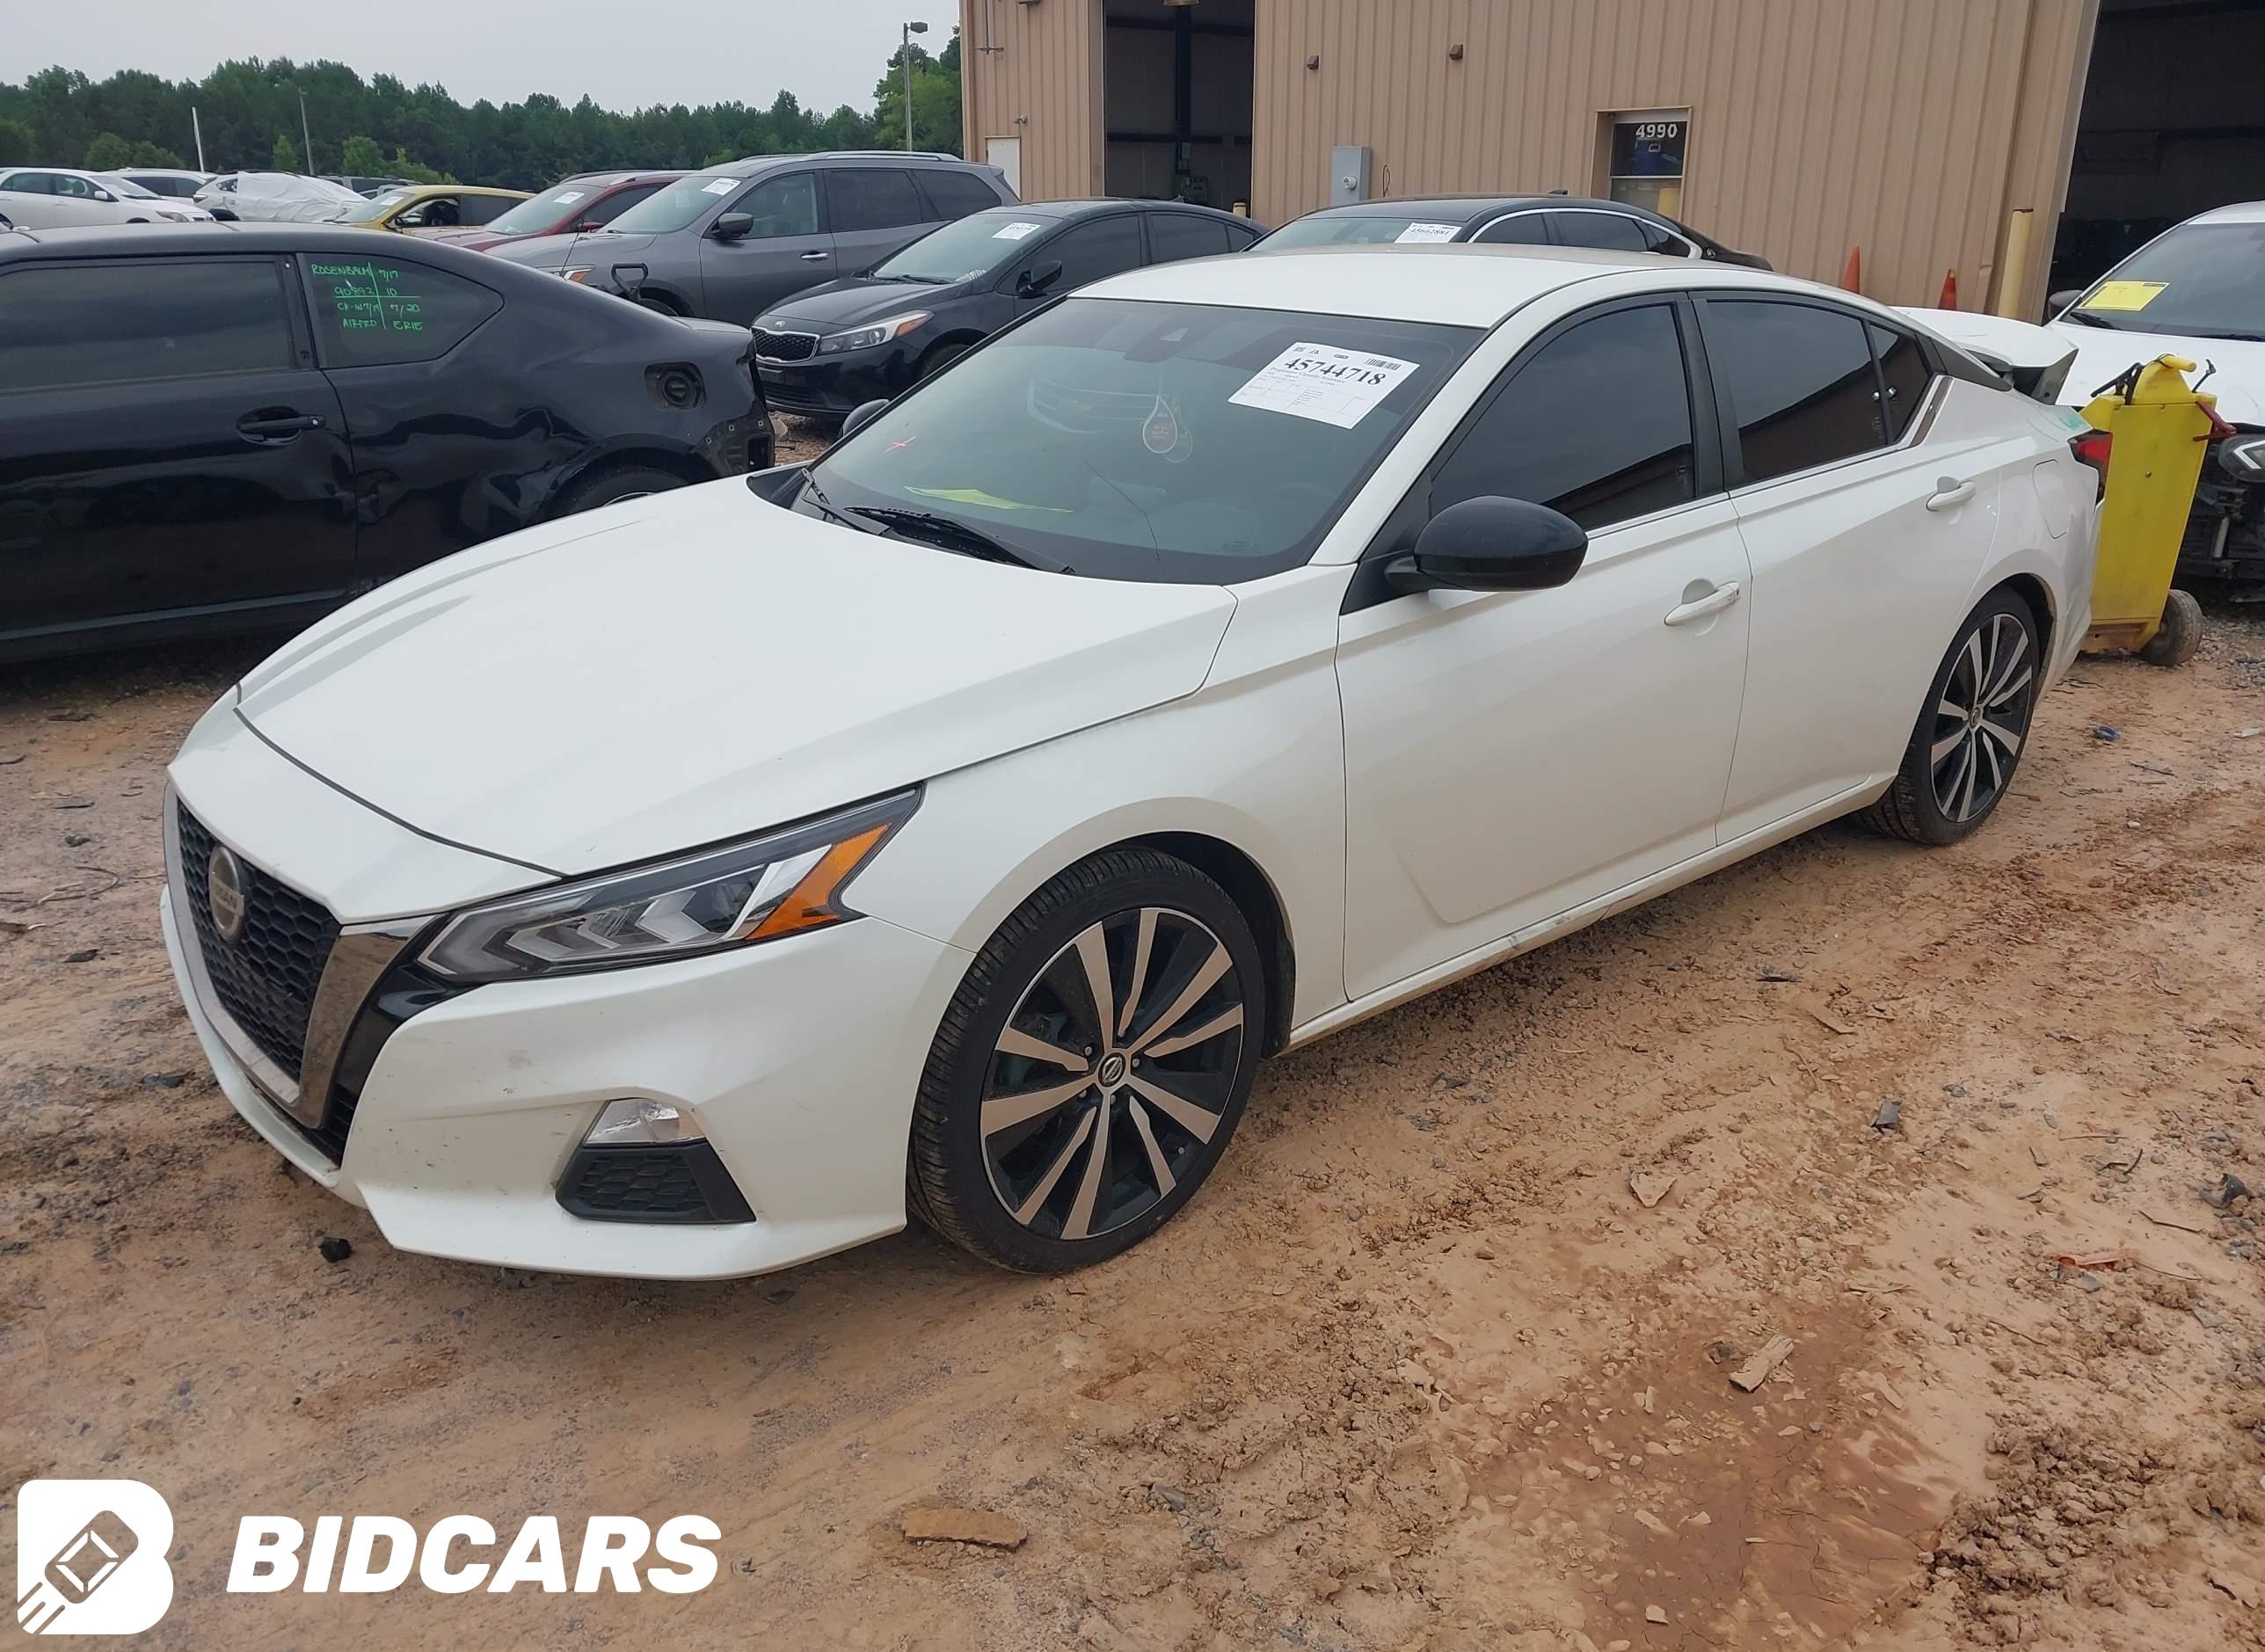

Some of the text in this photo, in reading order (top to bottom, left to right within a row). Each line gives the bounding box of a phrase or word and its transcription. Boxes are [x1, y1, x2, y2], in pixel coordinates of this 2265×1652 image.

[1635, 124, 1678, 138] 4990
[393, 321, 423, 331] ERIE
[1285, 357, 1387, 385] 45744718
